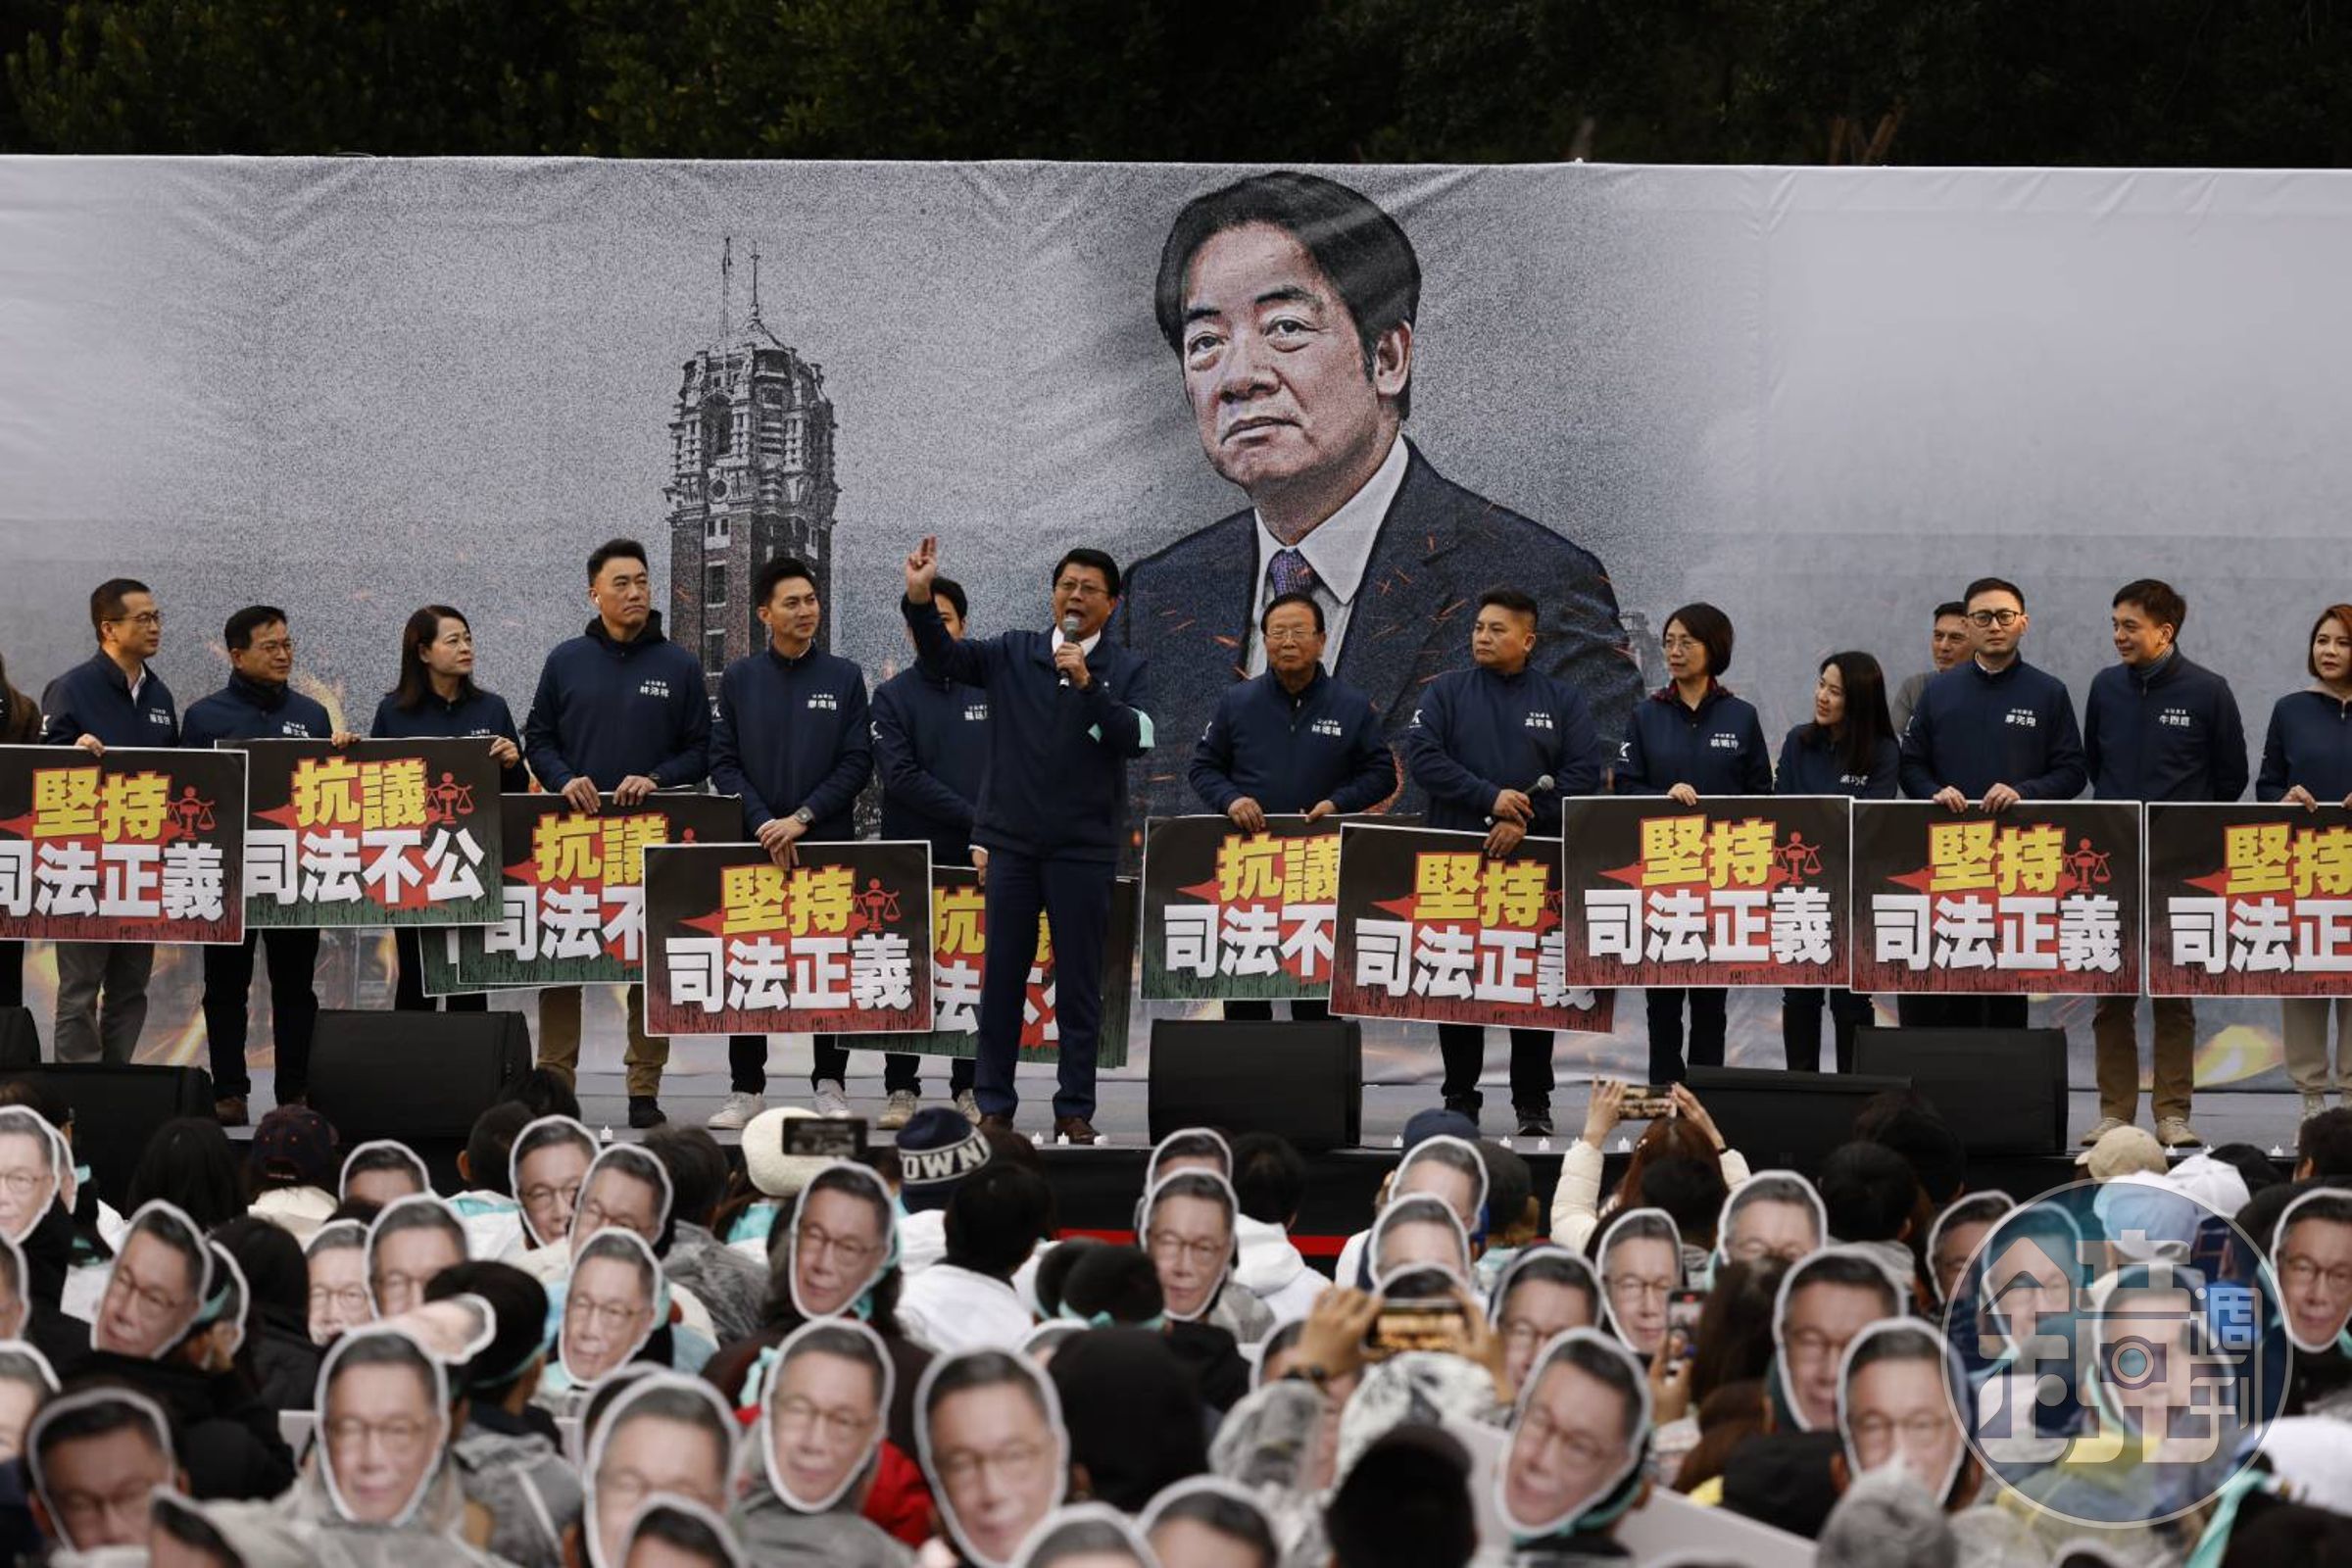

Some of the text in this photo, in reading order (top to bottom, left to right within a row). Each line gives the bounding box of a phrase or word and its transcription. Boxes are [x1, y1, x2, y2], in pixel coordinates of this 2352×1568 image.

[33, 769, 169, 842] 堅持
[296, 760, 426, 830] 抗議
[245, 828, 485, 905] 司法不公
[536, 814, 668, 887] 抗議
[1219, 833, 1339, 905] 抗議
[1643, 817, 1774, 889] 堅持
[1932, 823, 2062, 895] 堅持
[2228, 825, 2352, 896] 堅持
[724, 866, 855, 936] 堅持
[1415, 855, 1547, 927] 堅持
[1585, 887, 1833, 965] 司法正義
[1873, 895, 2122, 973] 司法正義
[666, 933, 912, 1013] 司法正義
